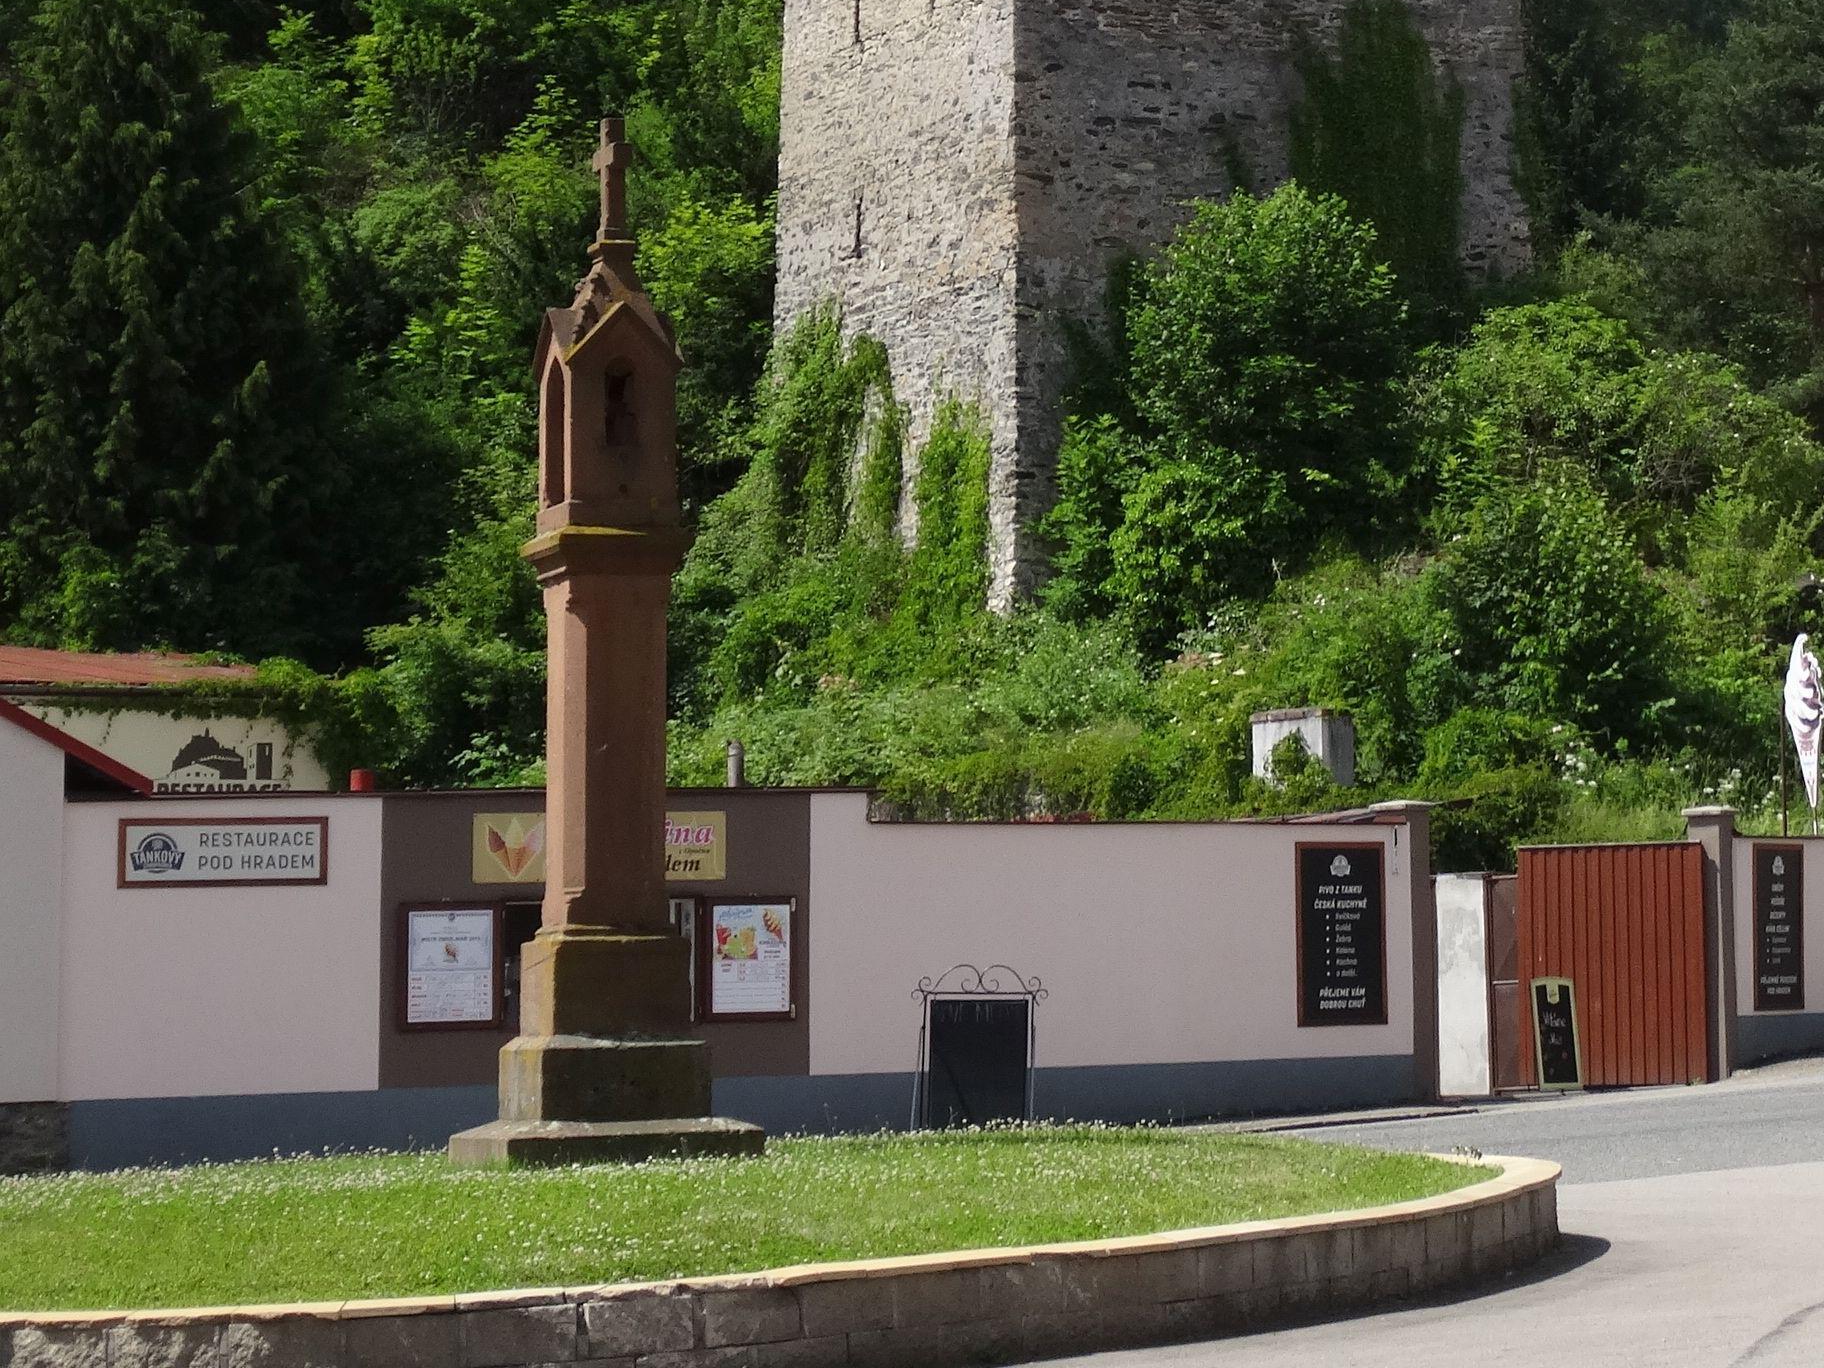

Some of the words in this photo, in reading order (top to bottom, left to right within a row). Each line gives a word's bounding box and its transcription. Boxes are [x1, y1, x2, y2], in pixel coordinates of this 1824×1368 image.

[199, 832, 315, 848] RESTAURACE
[198, 855, 233, 870] POD
[241, 855, 314, 870] HRADEM
